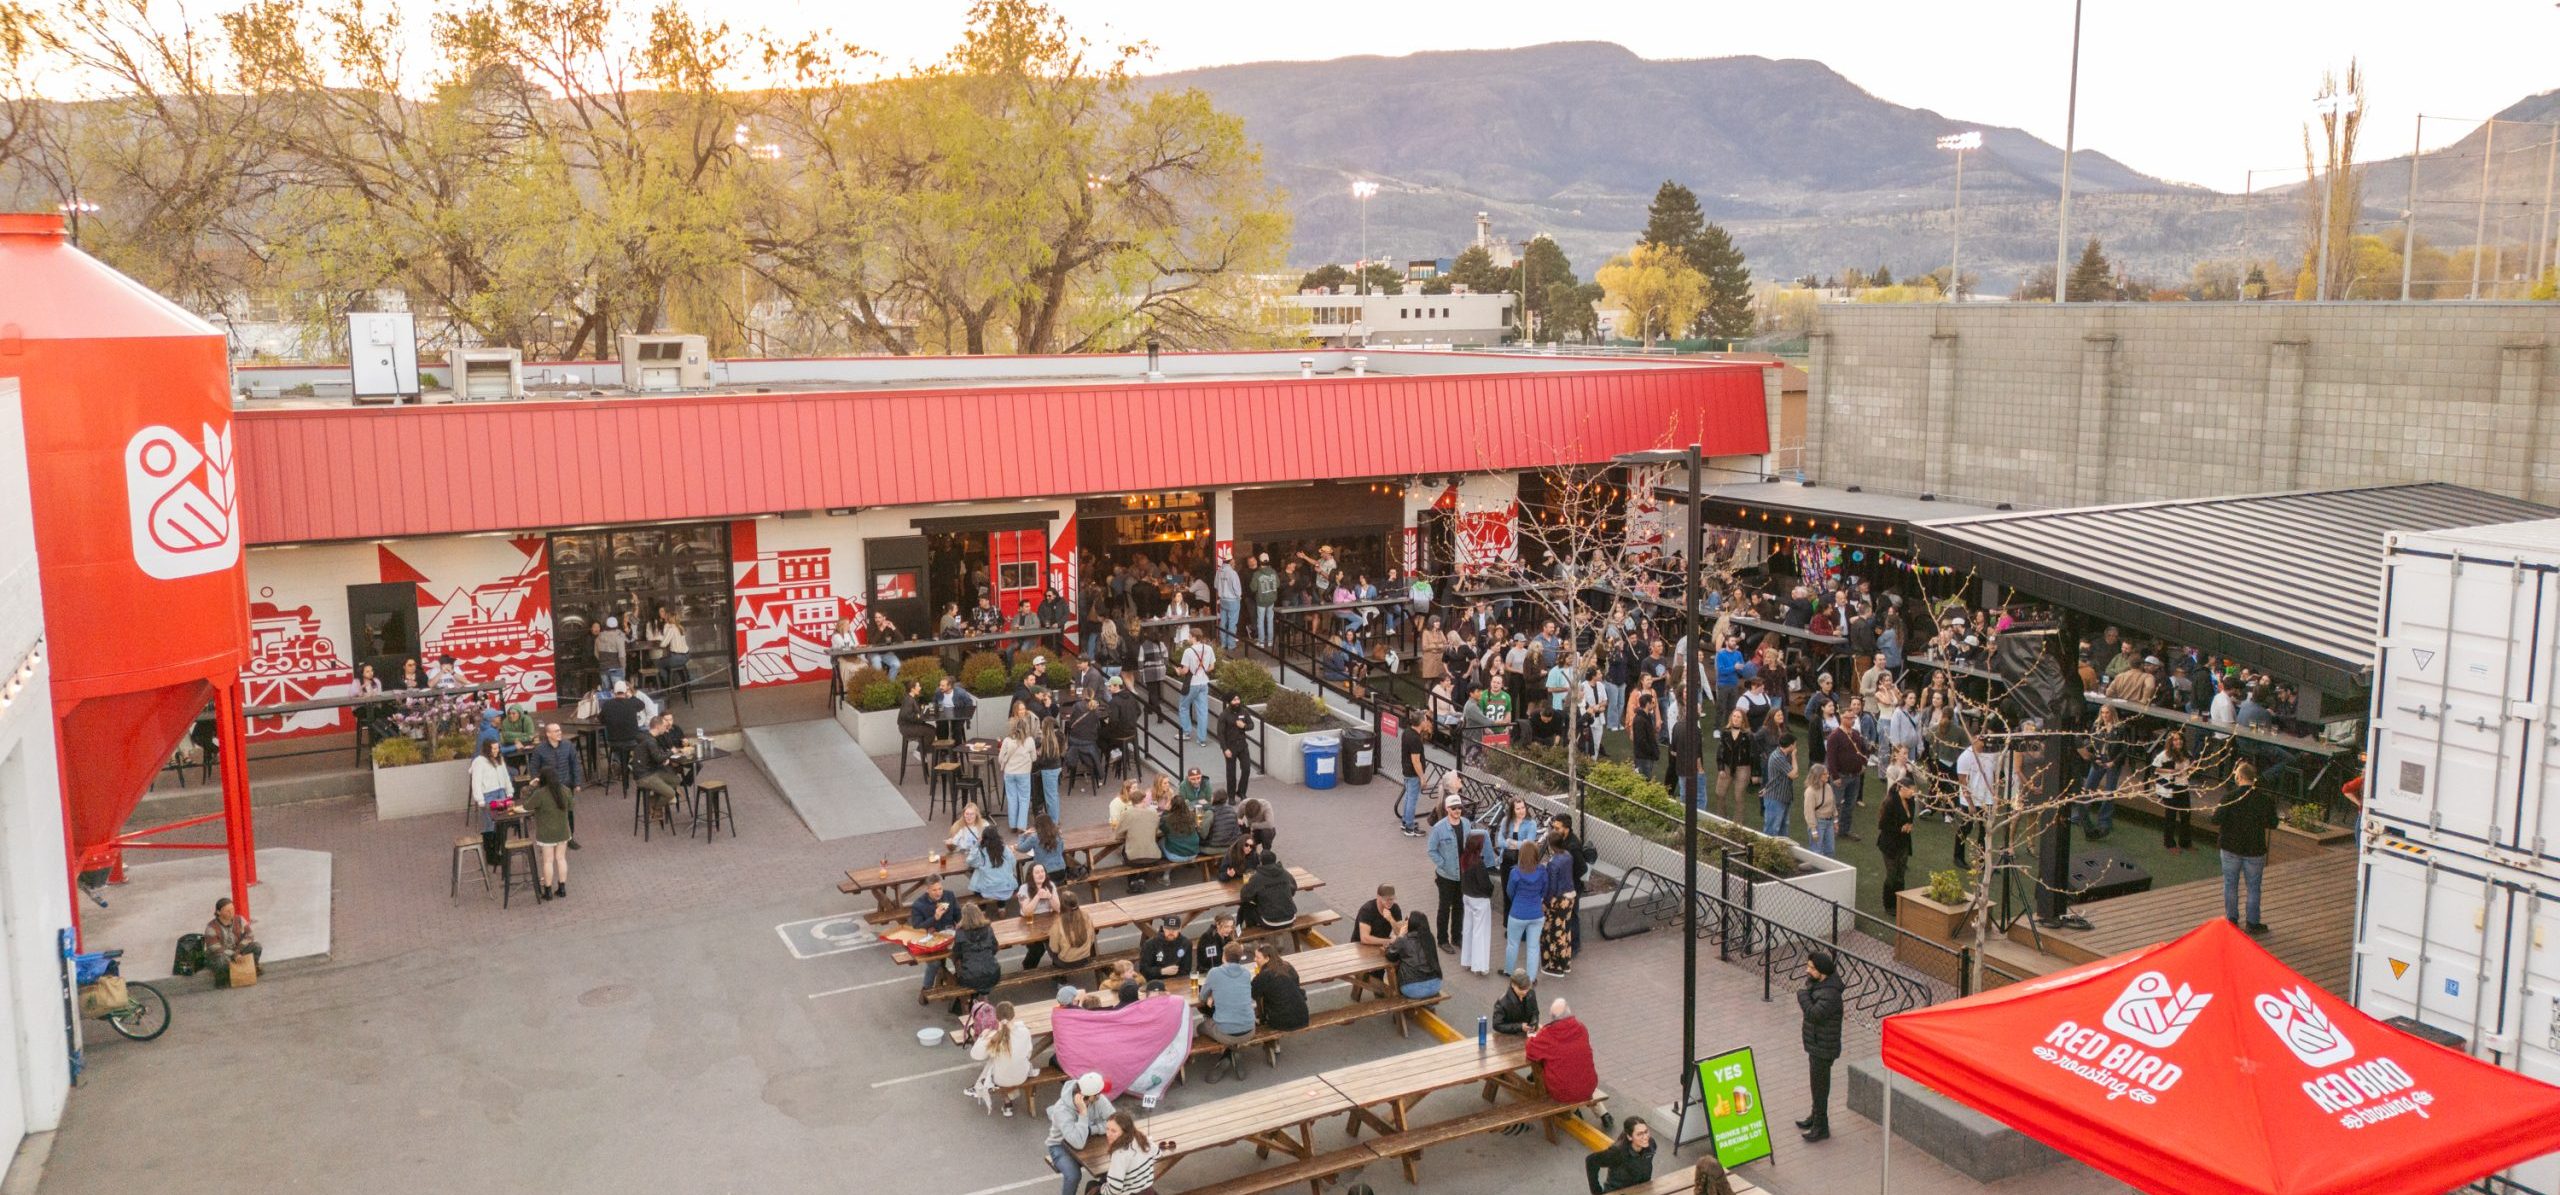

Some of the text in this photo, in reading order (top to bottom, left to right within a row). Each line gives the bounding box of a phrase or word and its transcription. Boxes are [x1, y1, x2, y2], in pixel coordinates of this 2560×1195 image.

[1486, 704, 1505, 721] 22
[2045, 1021, 2183, 1092] RED BIRD
[1713, 1063, 1743, 1083] YES
[2053, 1055, 2129, 1100] roasting
[2302, 1057, 2414, 1114] RED BIRD
[2352, 1096, 2429, 1124] brewing
[1715, 1119, 1763, 1141] DRINKS IN THE
[1719, 1133, 1749, 1149] PARKING
[1749, 1129, 1762, 1139] LOT
